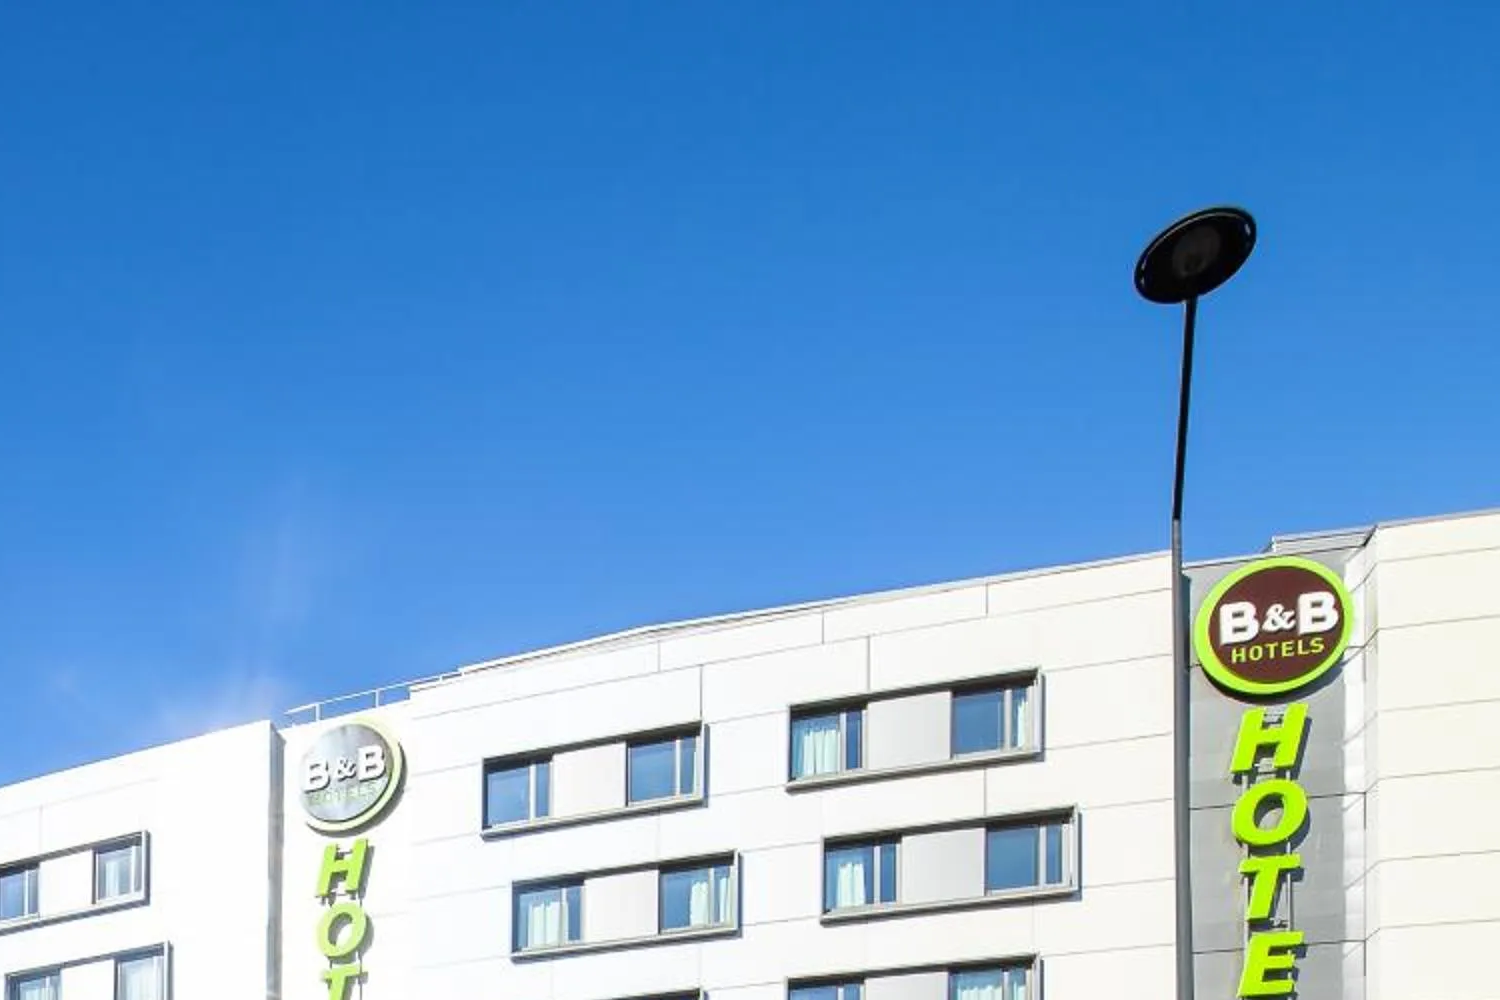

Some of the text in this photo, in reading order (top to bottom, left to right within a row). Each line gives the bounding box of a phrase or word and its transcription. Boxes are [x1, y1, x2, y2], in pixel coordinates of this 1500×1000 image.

[1219, 591, 1339, 646] B&B
[1231, 637, 1325, 664] HOTELS
[303, 745, 386, 794] B&B
